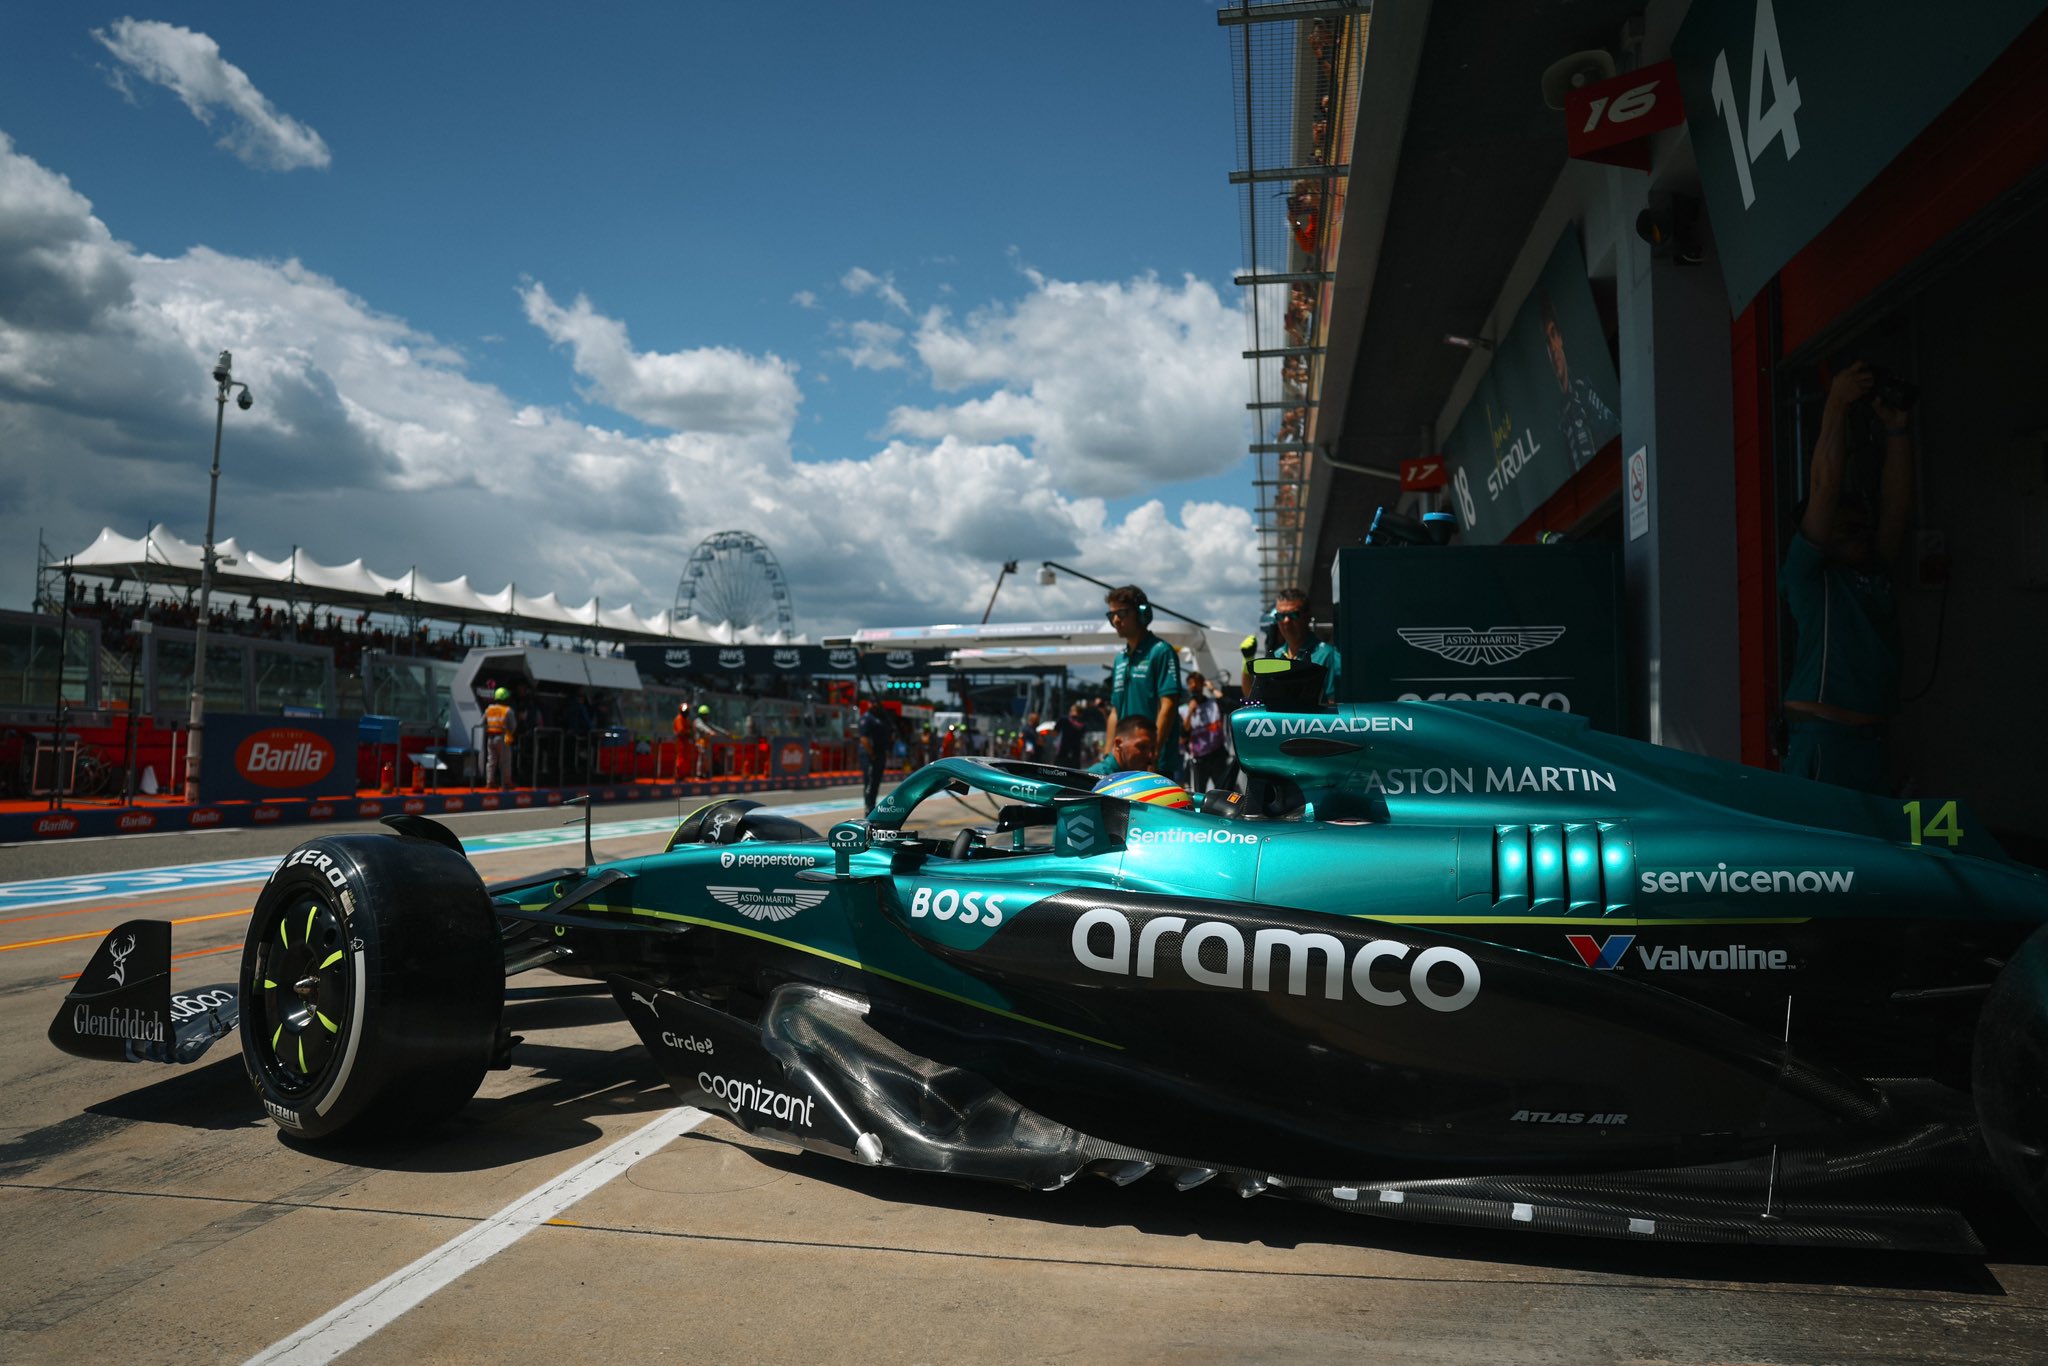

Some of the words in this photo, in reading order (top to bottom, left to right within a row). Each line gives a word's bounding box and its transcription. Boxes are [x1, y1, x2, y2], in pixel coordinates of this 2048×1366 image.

[1582, 80, 1662, 133] 16
[1711, 0, 1802, 211] 14
[1407, 463, 1440, 482] 17
[1487, 428, 1541, 501] STROLL
[1454, 466, 1476, 531] 18
[1445, 635, 1478, 645] ASTON
[1479, 634, 1518, 645] MARTIN
[665, 649, 691, 662] aws
[719, 649, 745, 662] aws
[773, 649, 801, 662] aws
[1281, 717, 1413, 735] MAADEN
[246, 742, 323, 772] Barilla
[1010, 783, 1038, 800] citi
[1363, 768, 1474, 795] ASTON
[1486, 766, 1617, 793] MARTIN
[877, 804, 905, 814] NexGen
[38, 819, 75, 833] Barilla
[120, 815, 153, 828] Barilla
[1902, 800, 1965, 847] 14
[1129, 827, 1258, 845] SentinelOne
[286, 849, 348, 888] ZERO
[738, 854, 815, 868] pepperstone
[1640, 862, 1855, 894] servicenow
[740, 894, 764, 903] ASTON
[765, 894, 794, 904] MARTIN
[910, 886, 1004, 928] BOSS
[1071, 907, 1482, 1012] aramco
[1636, 944, 1789, 971] Valvoline
[73, 1003, 165, 1042] Glenfiddich
[698, 1071, 815, 1127] cognizant
[1510, 1109, 1585, 1124] ATLAS
[1587, 1113, 1629, 1125] AIR
